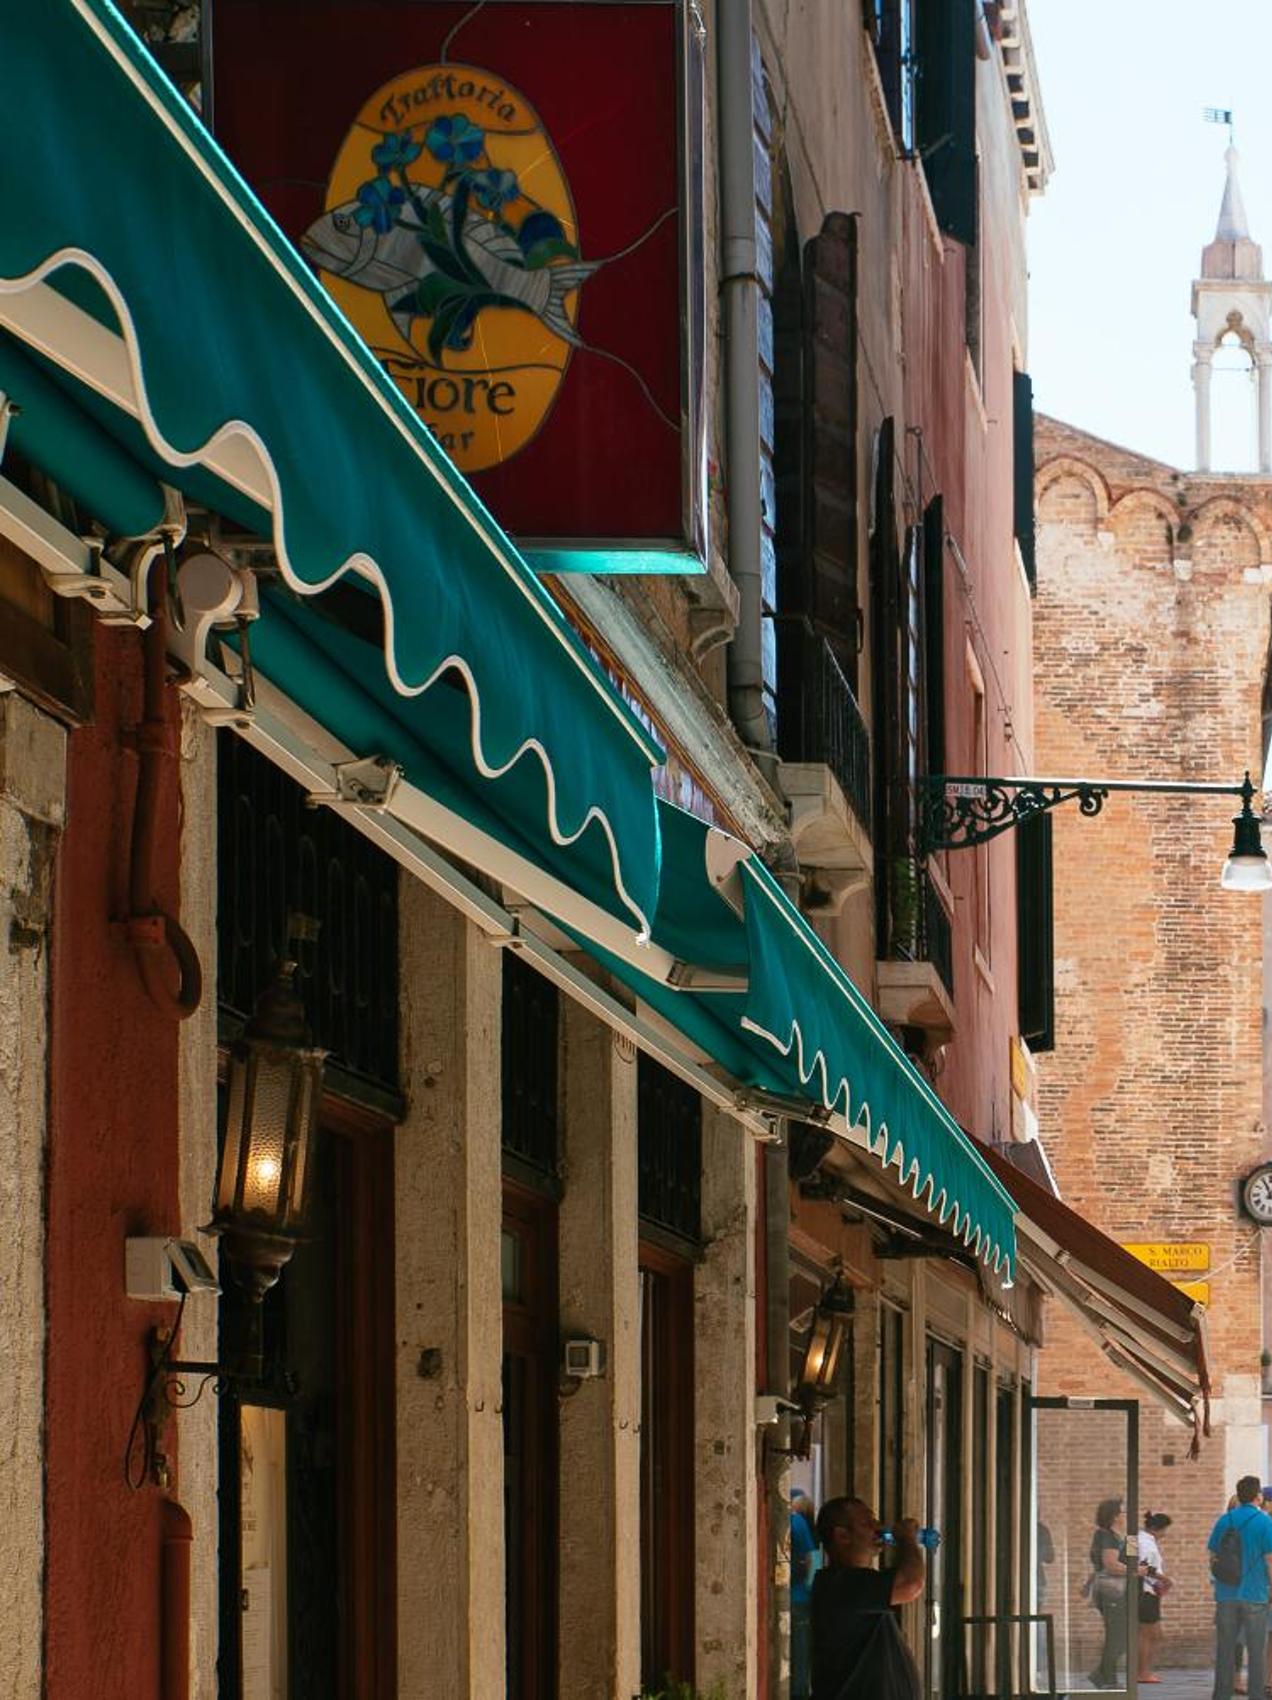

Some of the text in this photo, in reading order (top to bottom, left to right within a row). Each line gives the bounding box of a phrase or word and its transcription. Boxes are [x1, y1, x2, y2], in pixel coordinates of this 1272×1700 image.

[380, 71, 517, 126] Trattoria
[1162, 1246, 1203, 1257] MARCO
[1149, 1258, 1190, 1268] RIALTO
